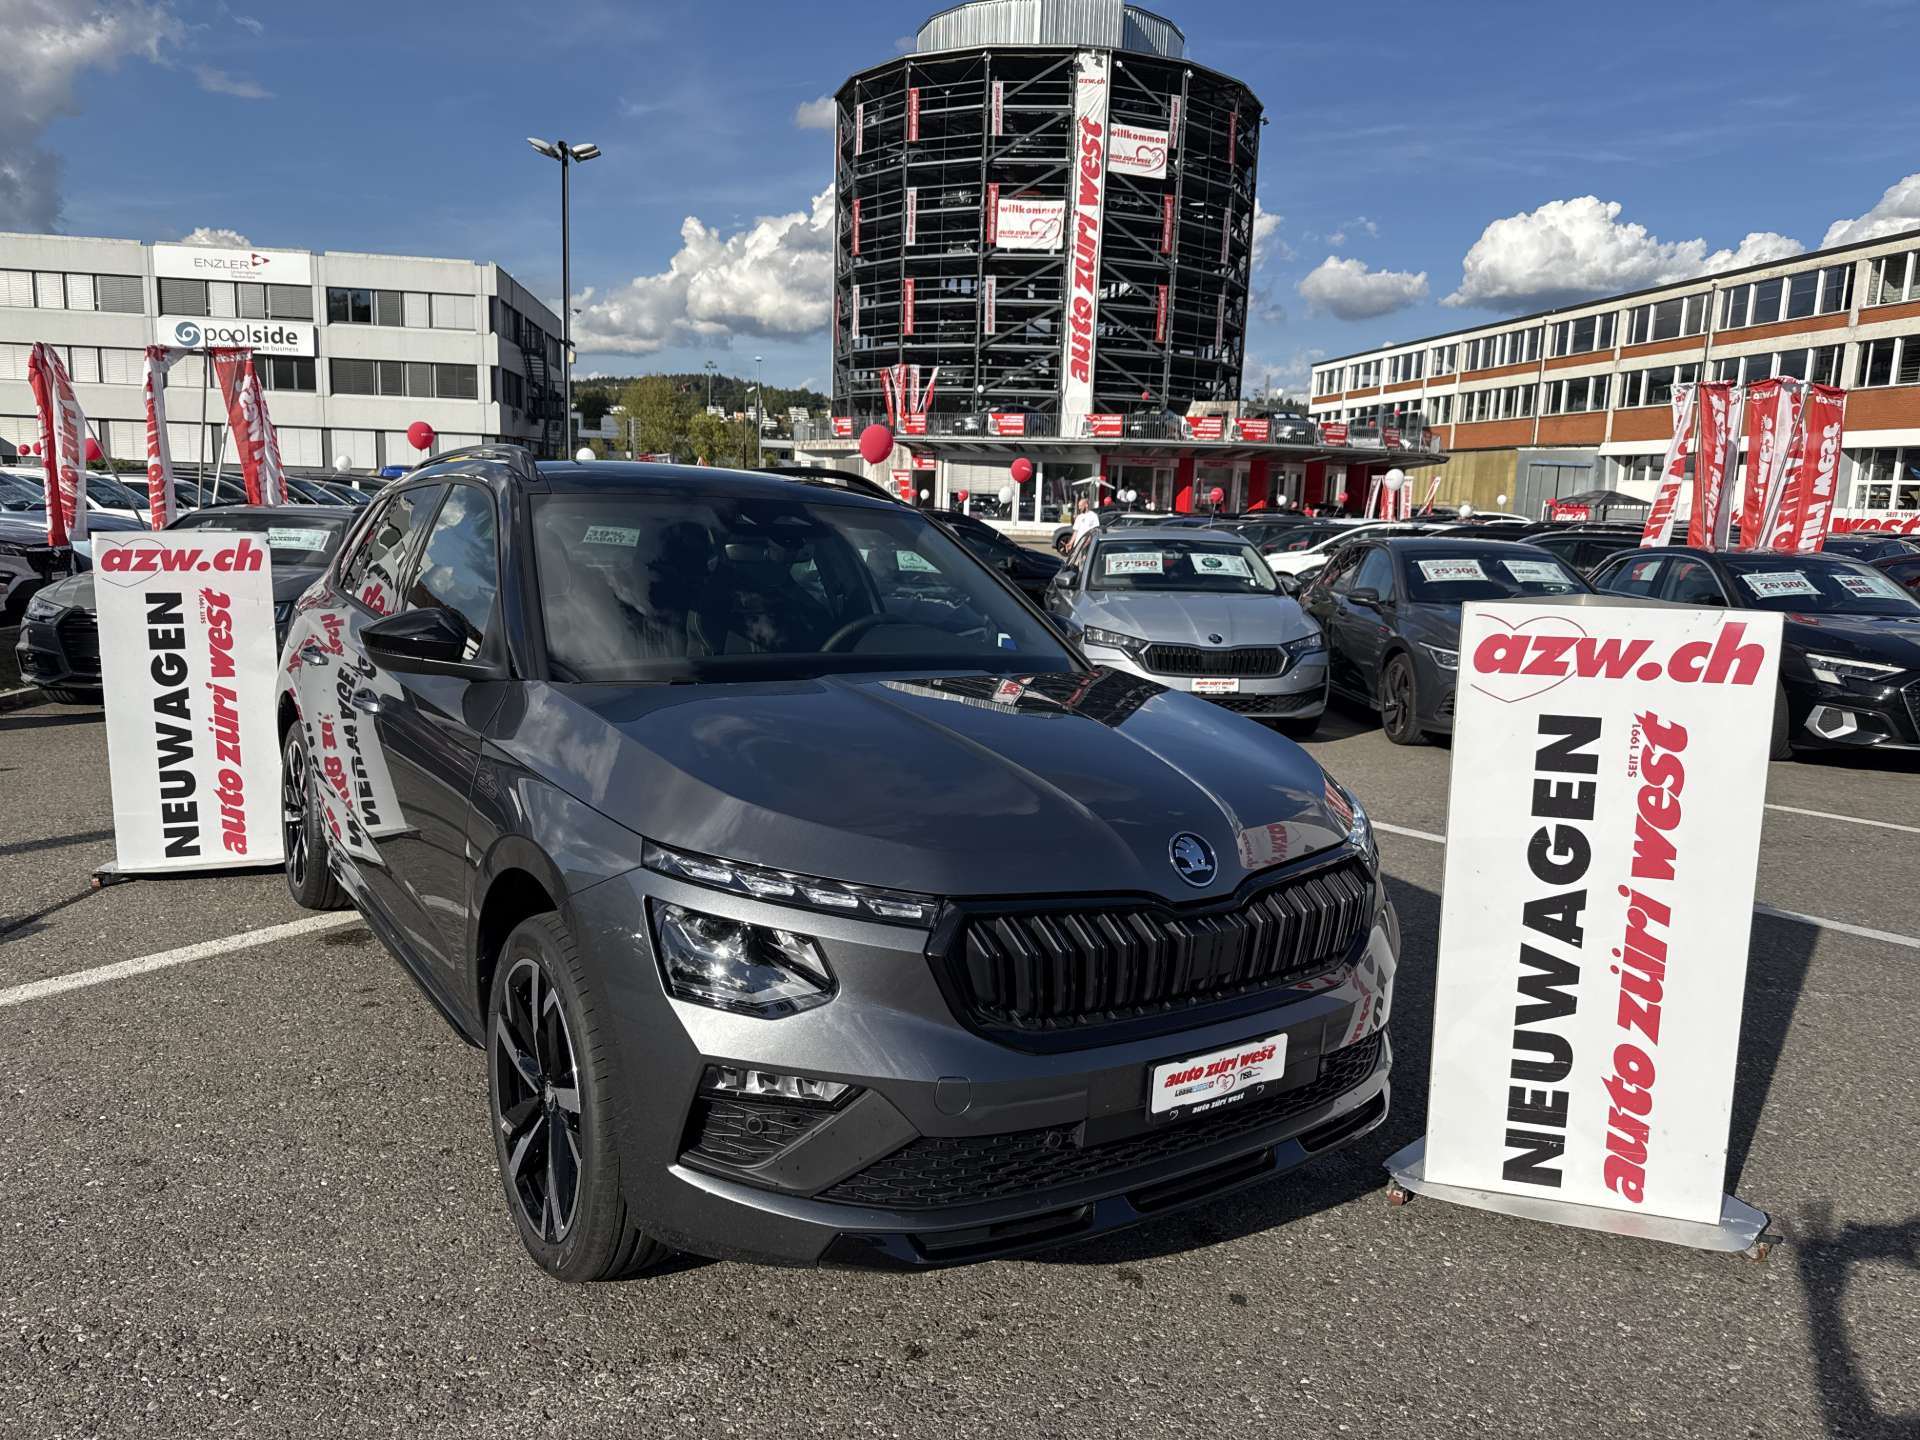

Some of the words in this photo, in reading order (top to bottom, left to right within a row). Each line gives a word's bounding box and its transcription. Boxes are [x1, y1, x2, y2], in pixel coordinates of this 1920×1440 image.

[1078, 77, 1105, 85] azw.ch
[1078, 115, 1103, 206] west
[1109, 128, 1167, 144] willkommen
[194, 258, 250, 270] ENZLER
[1073, 210, 1098, 295] züri
[204, 323, 298, 345] poolside
[1071, 297, 1093, 383] auto
[101, 539, 263, 572] azw.ch
[200, 587, 235, 678] west
[1472, 621, 1766, 686] azw.ch
[145, 592, 201, 858] NEUWAGEN
[205, 682, 242, 768] züri
[1628, 754, 1639, 778] SEIT
[1630, 724, 1641, 750] 1991
[215, 768, 248, 856] auto
[1630, 710, 1689, 881] west
[1502, 713, 1603, 1188] NEUWAGEN
[1610, 884, 1671, 1048] züri
[1164, 1066, 1204, 1088] auto
[1205, 1052, 1240, 1078] züri
[1240, 1044, 1277, 1067] west
[1191, 1102, 1210, 1114] auto
[1228, 1092, 1245, 1105] west
[1601, 1043, 1657, 1204] auto
